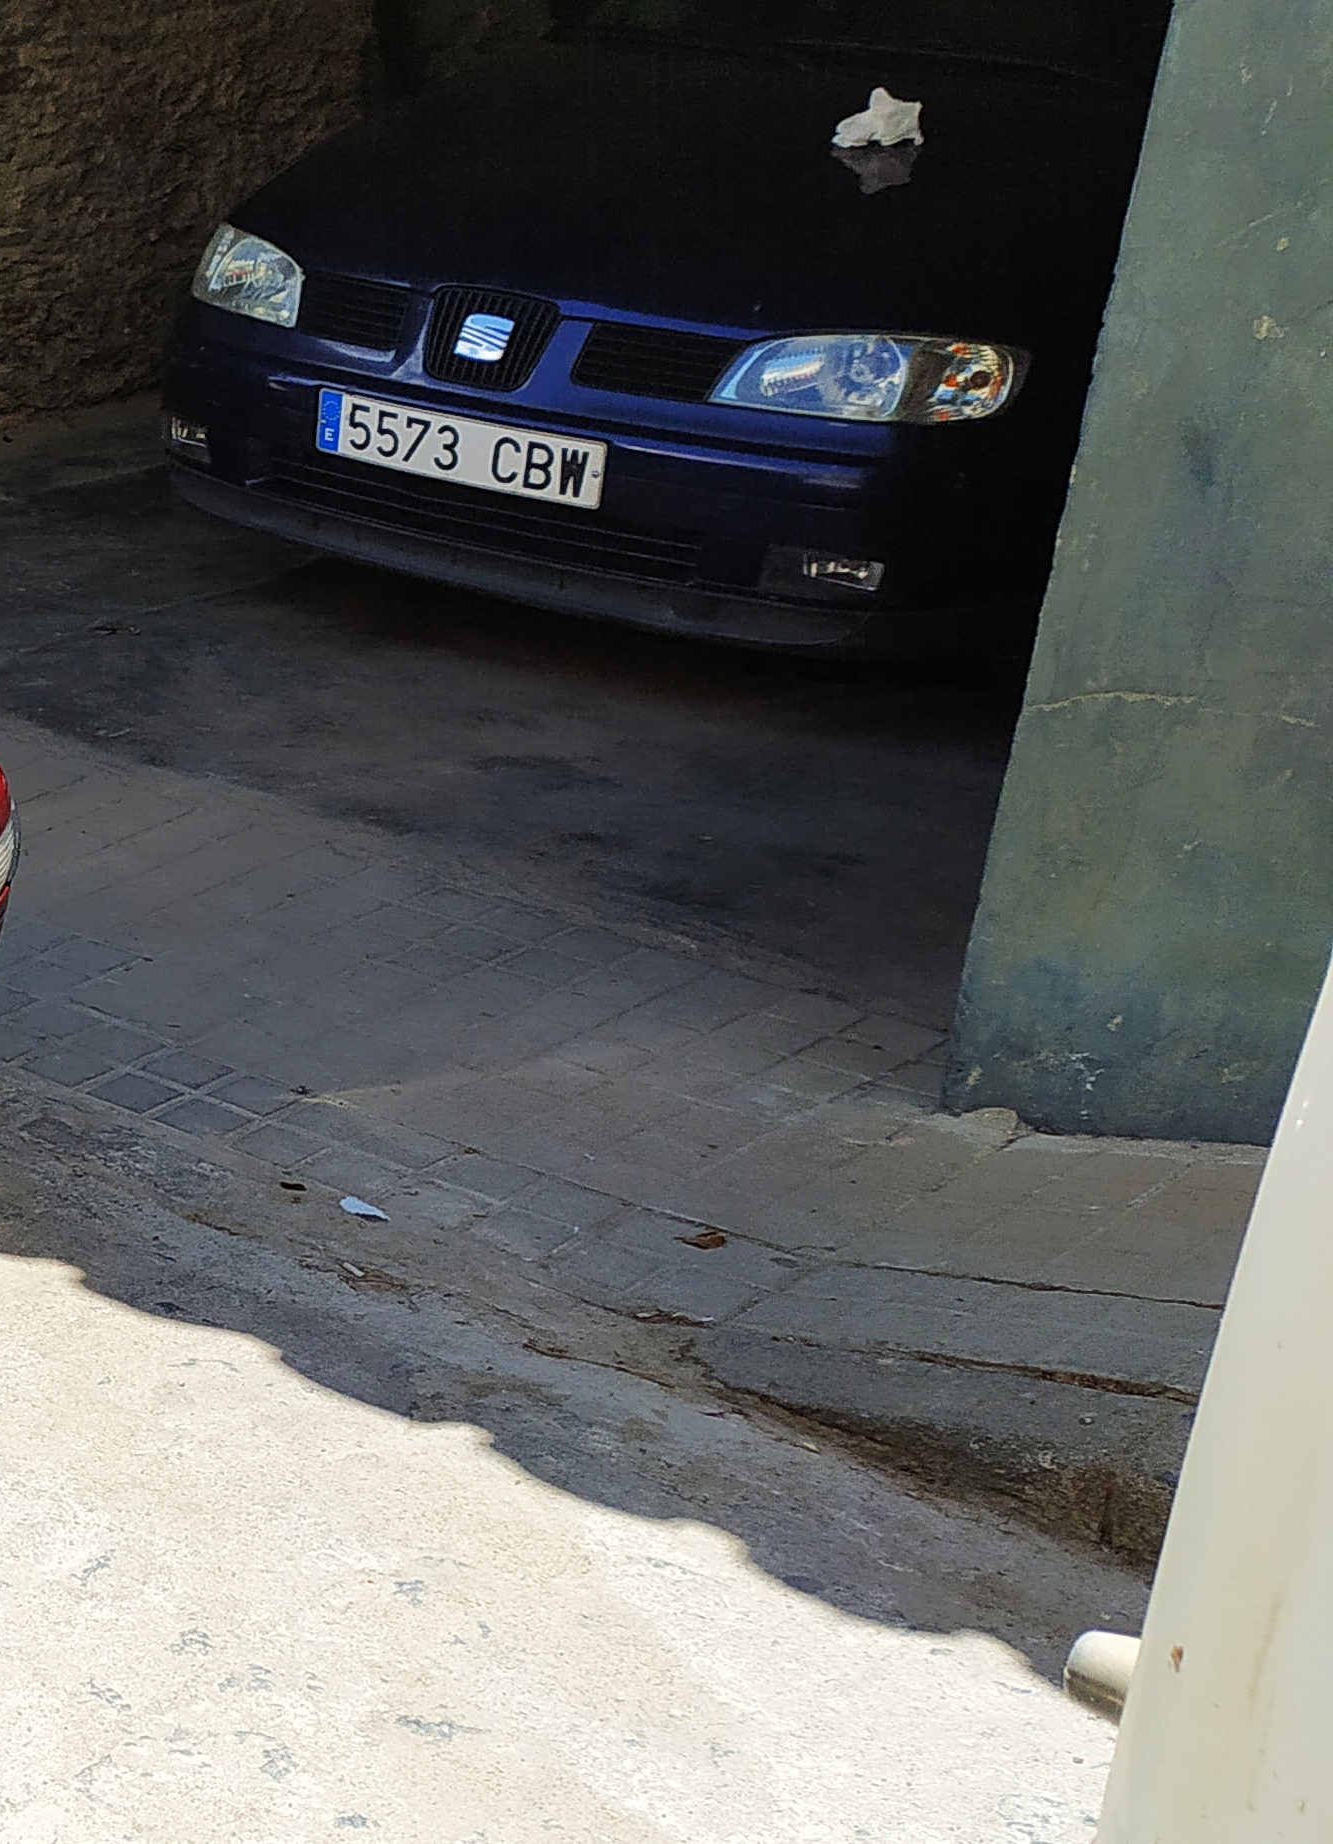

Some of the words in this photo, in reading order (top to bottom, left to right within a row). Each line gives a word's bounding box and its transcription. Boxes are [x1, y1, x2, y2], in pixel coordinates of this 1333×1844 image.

[324, 428, 334, 441] E
[348, 403, 460, 471] 5573
[491, 436, 590, 498] CBW
